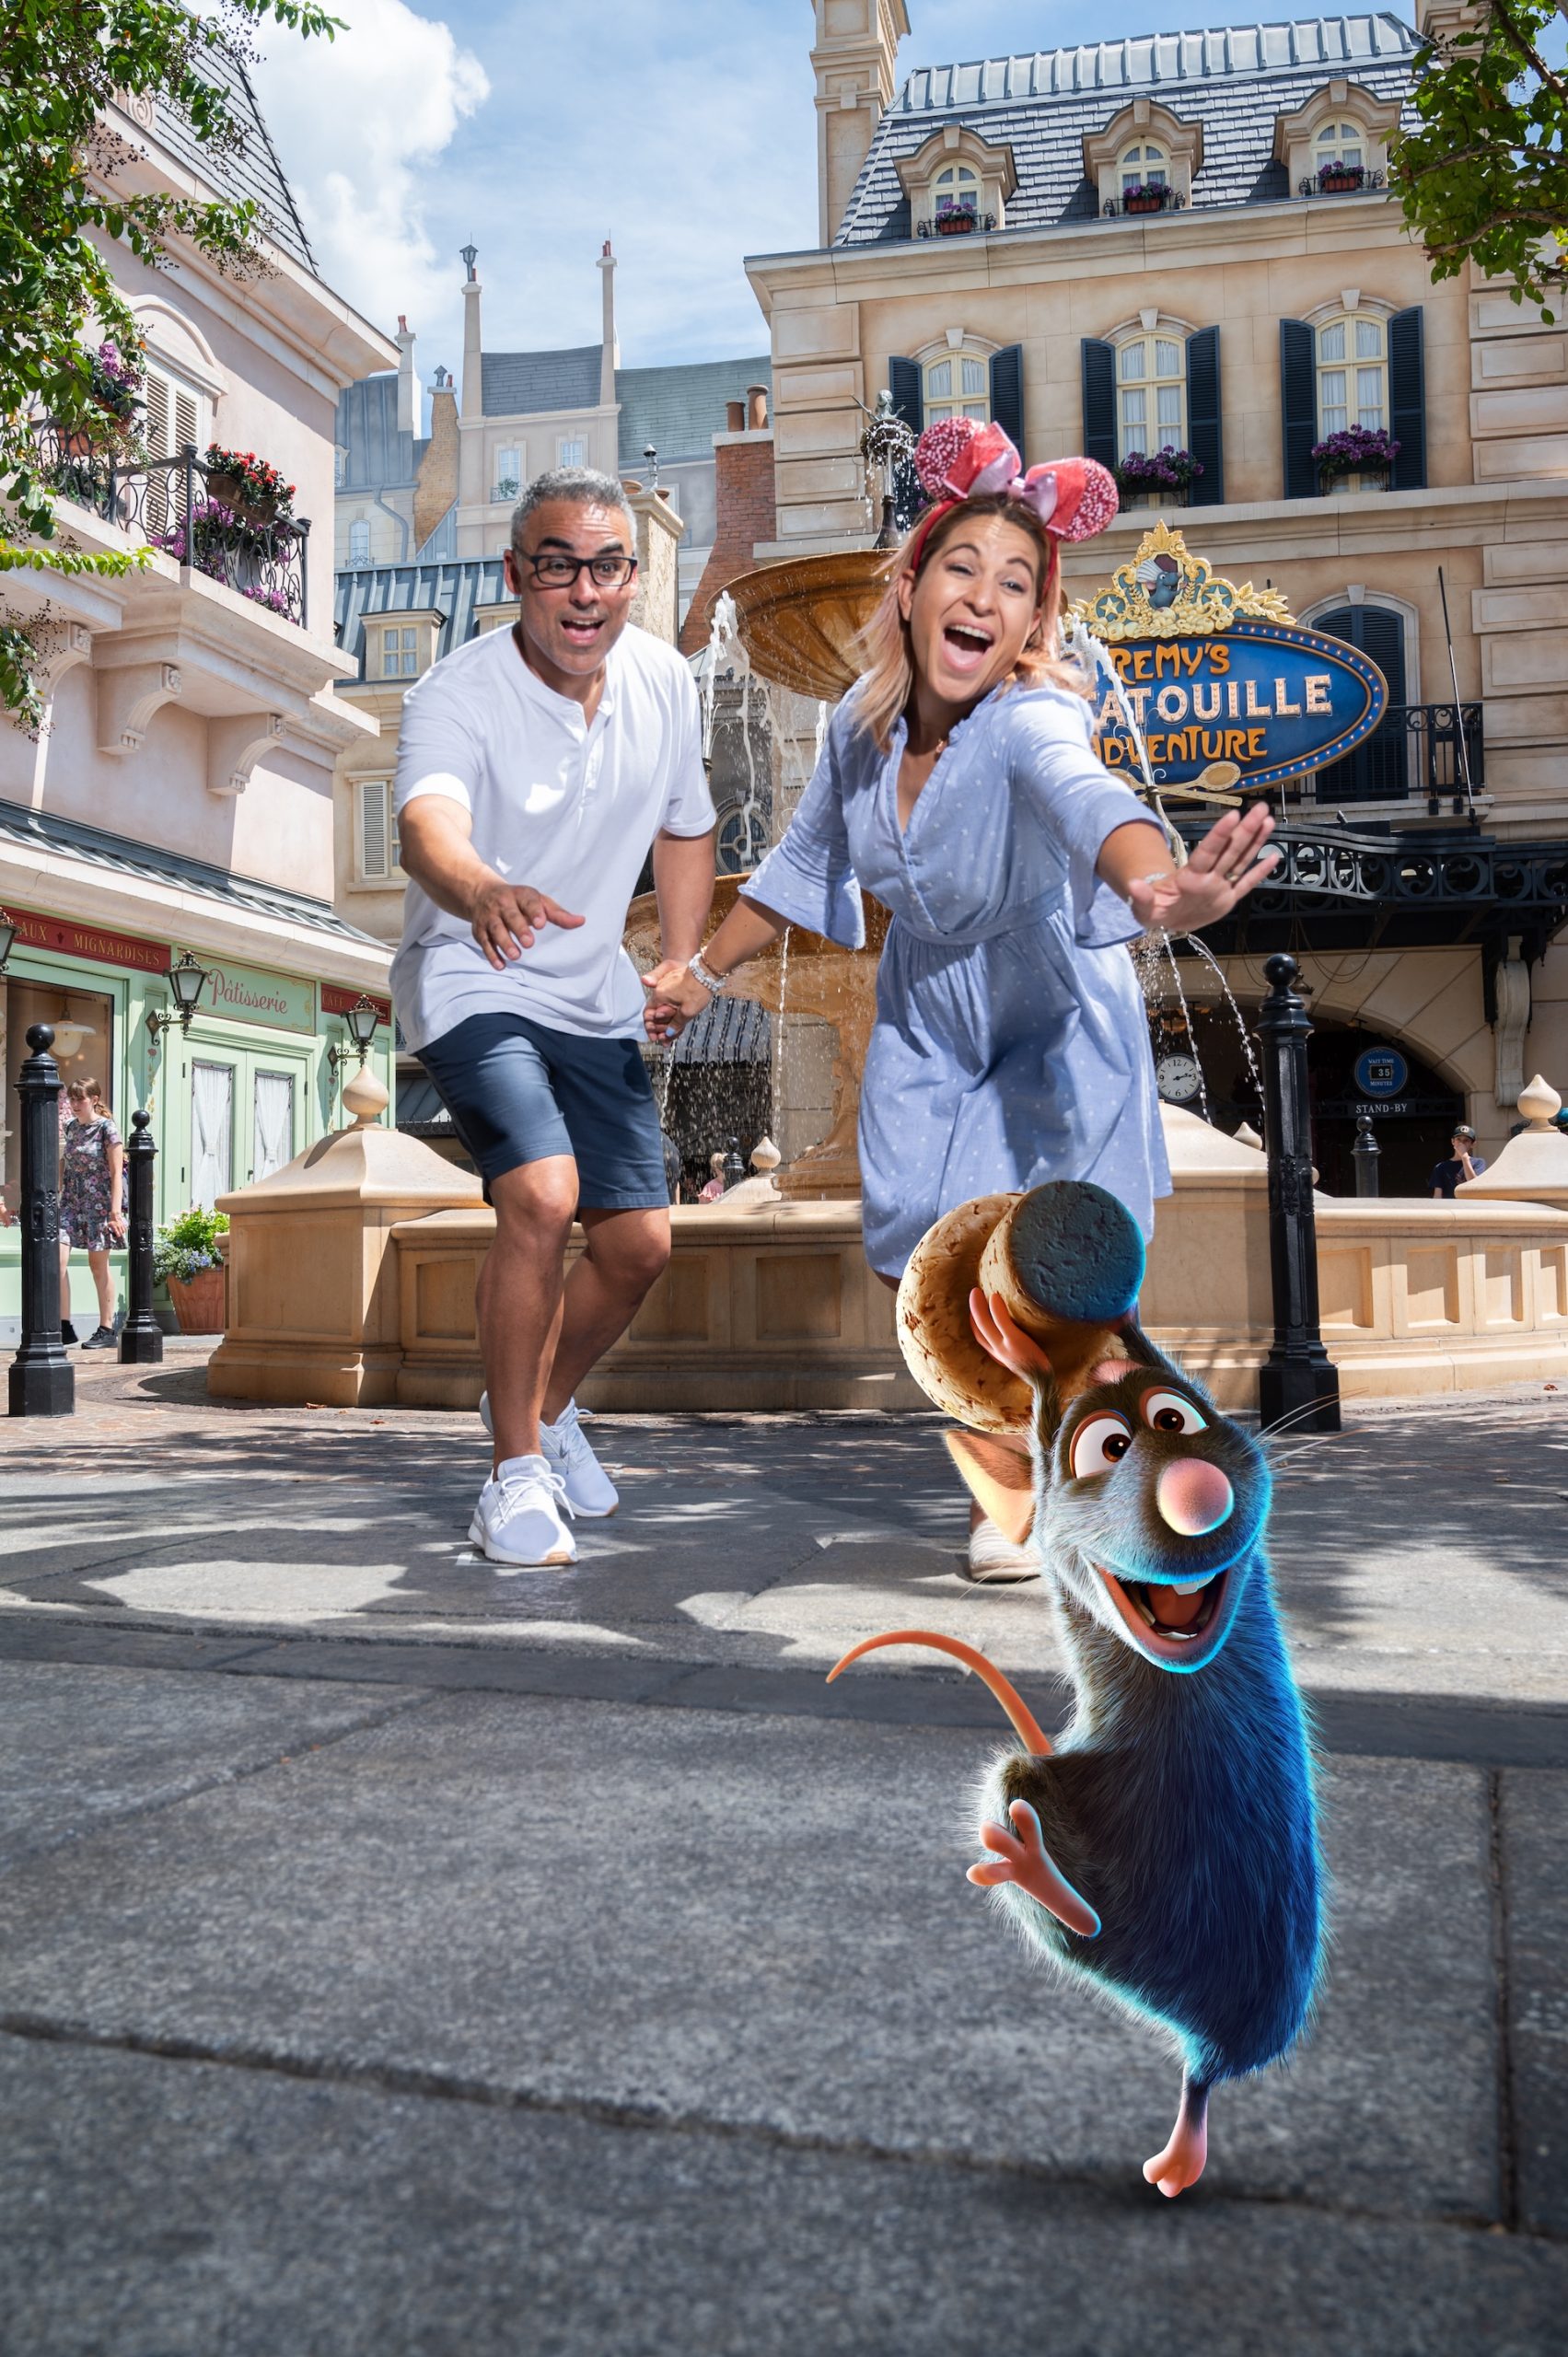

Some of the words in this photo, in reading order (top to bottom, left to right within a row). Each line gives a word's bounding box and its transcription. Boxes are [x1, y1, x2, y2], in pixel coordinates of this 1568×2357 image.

[1108, 643, 1231, 685] REMY'S
[1087, 674, 1332, 728] ATOUILLE
[74, 934, 160, 966] MIGNARDISES
[208, 969, 288, 1015] Pâtisserie
[1377, 1068, 1390, 1076] 35
[1355, 1103, 1408, 1114] STAND-BY
